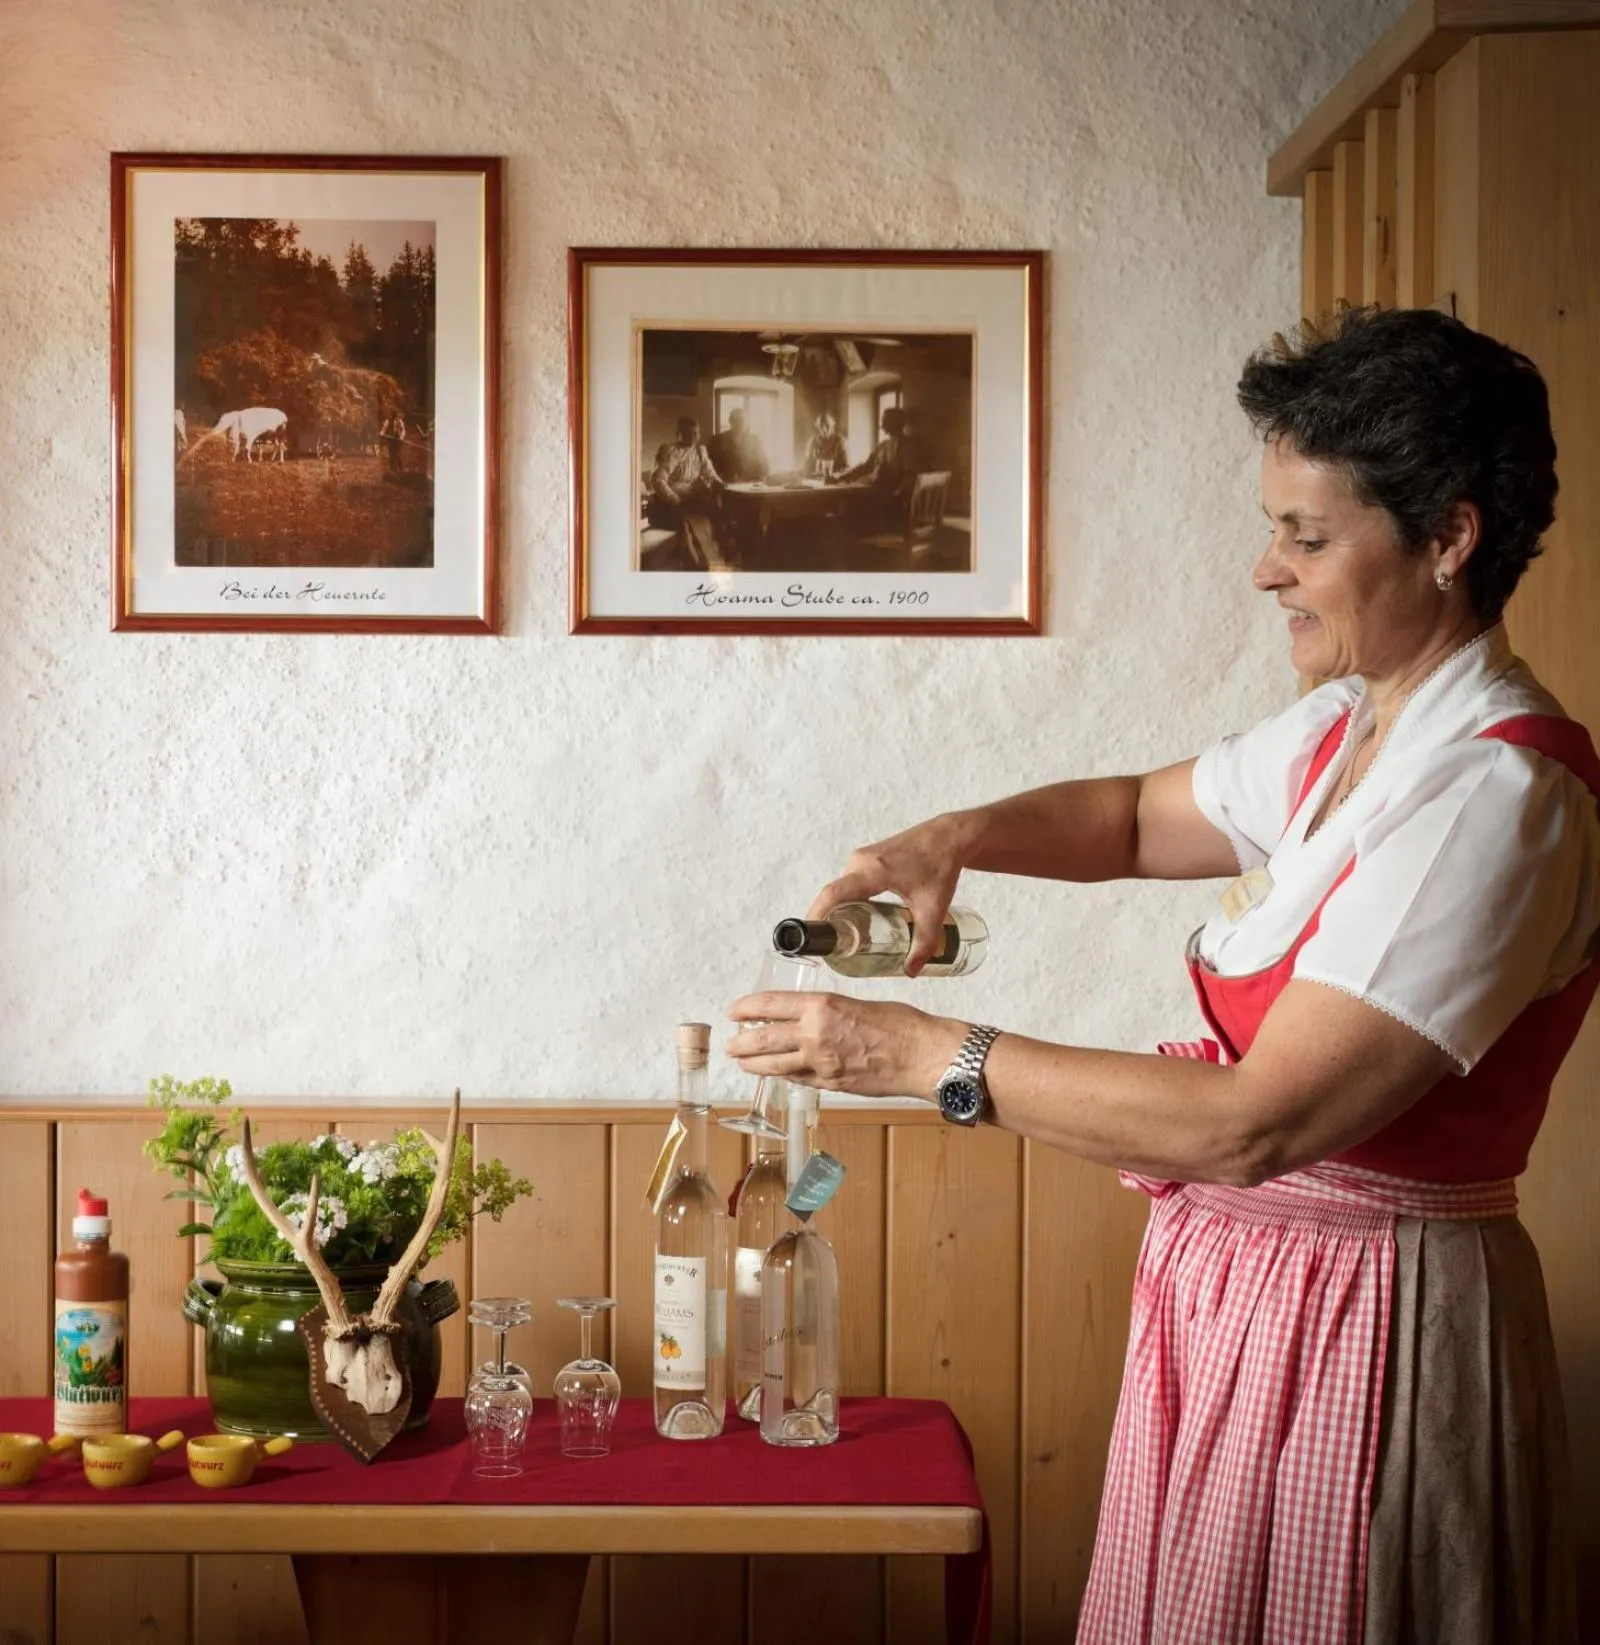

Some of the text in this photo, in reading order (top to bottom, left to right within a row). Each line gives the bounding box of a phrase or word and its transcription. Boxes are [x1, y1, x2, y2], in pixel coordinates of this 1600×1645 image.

[219, 581, 387, 602] Bei der Heuernte
[781, 584, 845, 607] Stube
[851, 594, 880, 605] ca.
[888, 590, 929, 605] 1900
